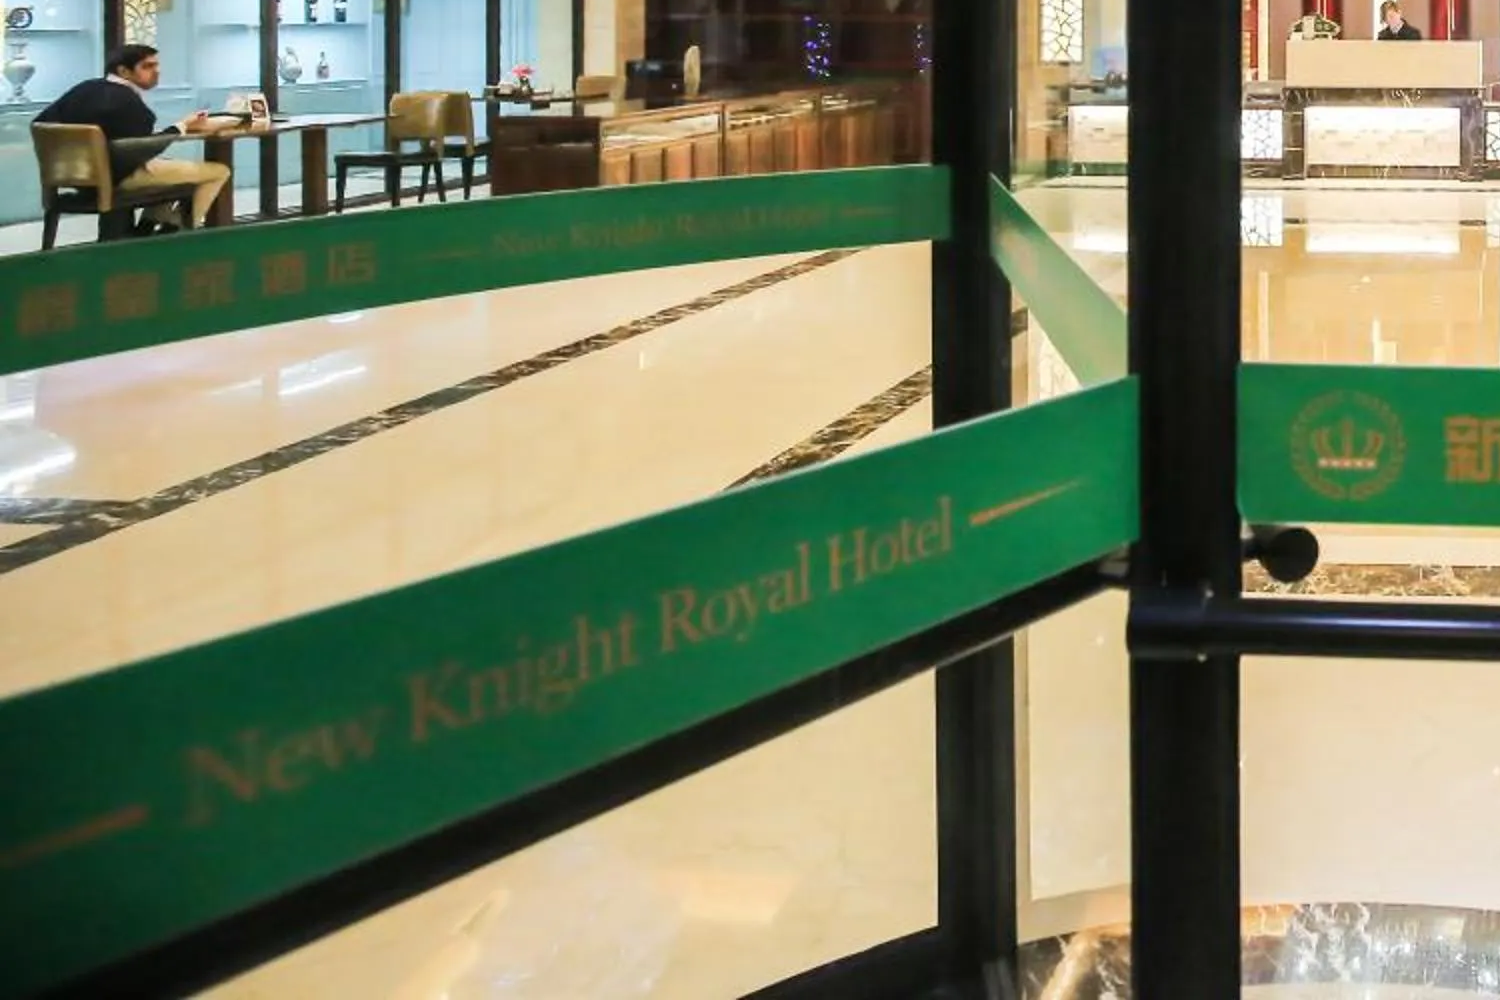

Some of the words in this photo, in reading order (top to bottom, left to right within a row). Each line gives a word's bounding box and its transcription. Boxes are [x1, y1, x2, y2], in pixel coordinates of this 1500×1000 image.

[182, 708, 392, 826] New
[403, 606, 640, 742] Knight
[657, 540, 813, 648] Royal
[825, 494, 955, 597] Hotel
